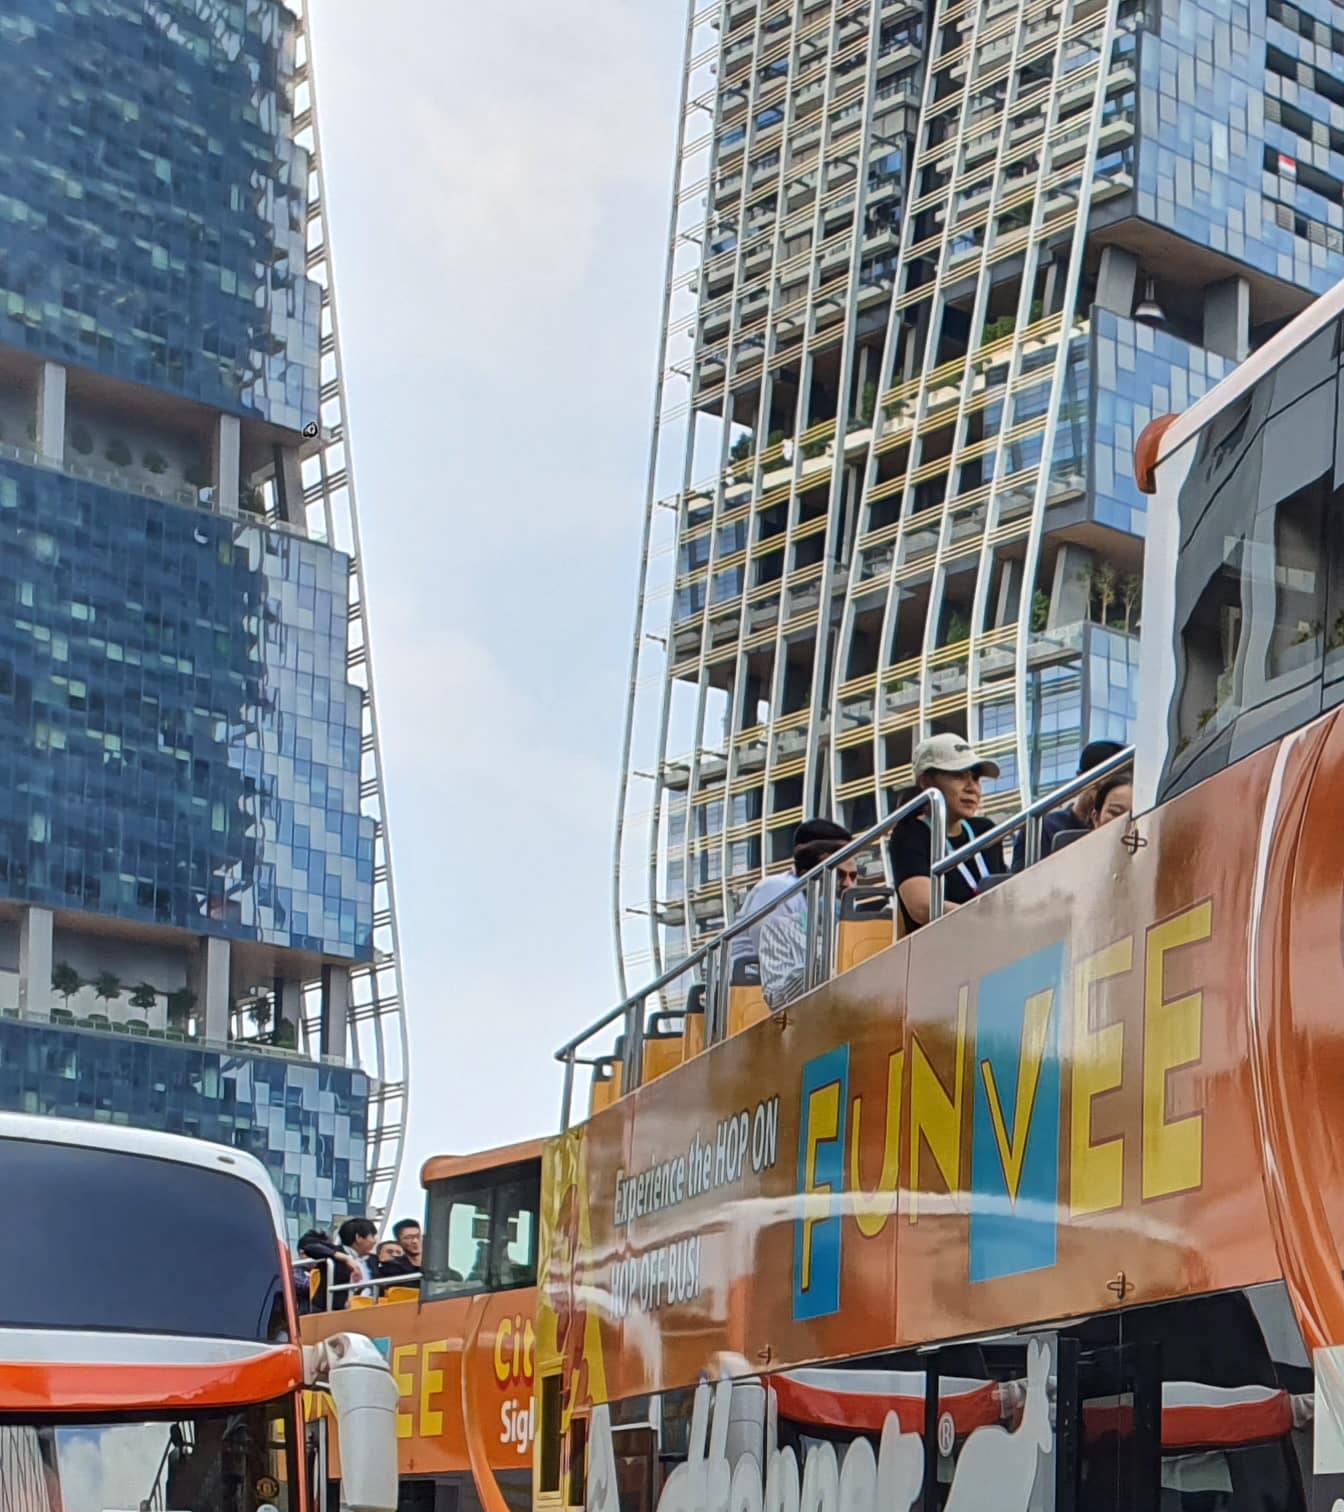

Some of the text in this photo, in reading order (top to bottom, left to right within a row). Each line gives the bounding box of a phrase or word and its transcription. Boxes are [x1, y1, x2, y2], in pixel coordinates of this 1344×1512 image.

[800, 901, 1213, 1292] FUNVEE
[614, 1096, 779, 1242] Experience the HOP ON
[610, 1256, 637, 1319] HOP
[640, 1246, 666, 1313] OFF
[494, 1315, 535, 1386] Cit
